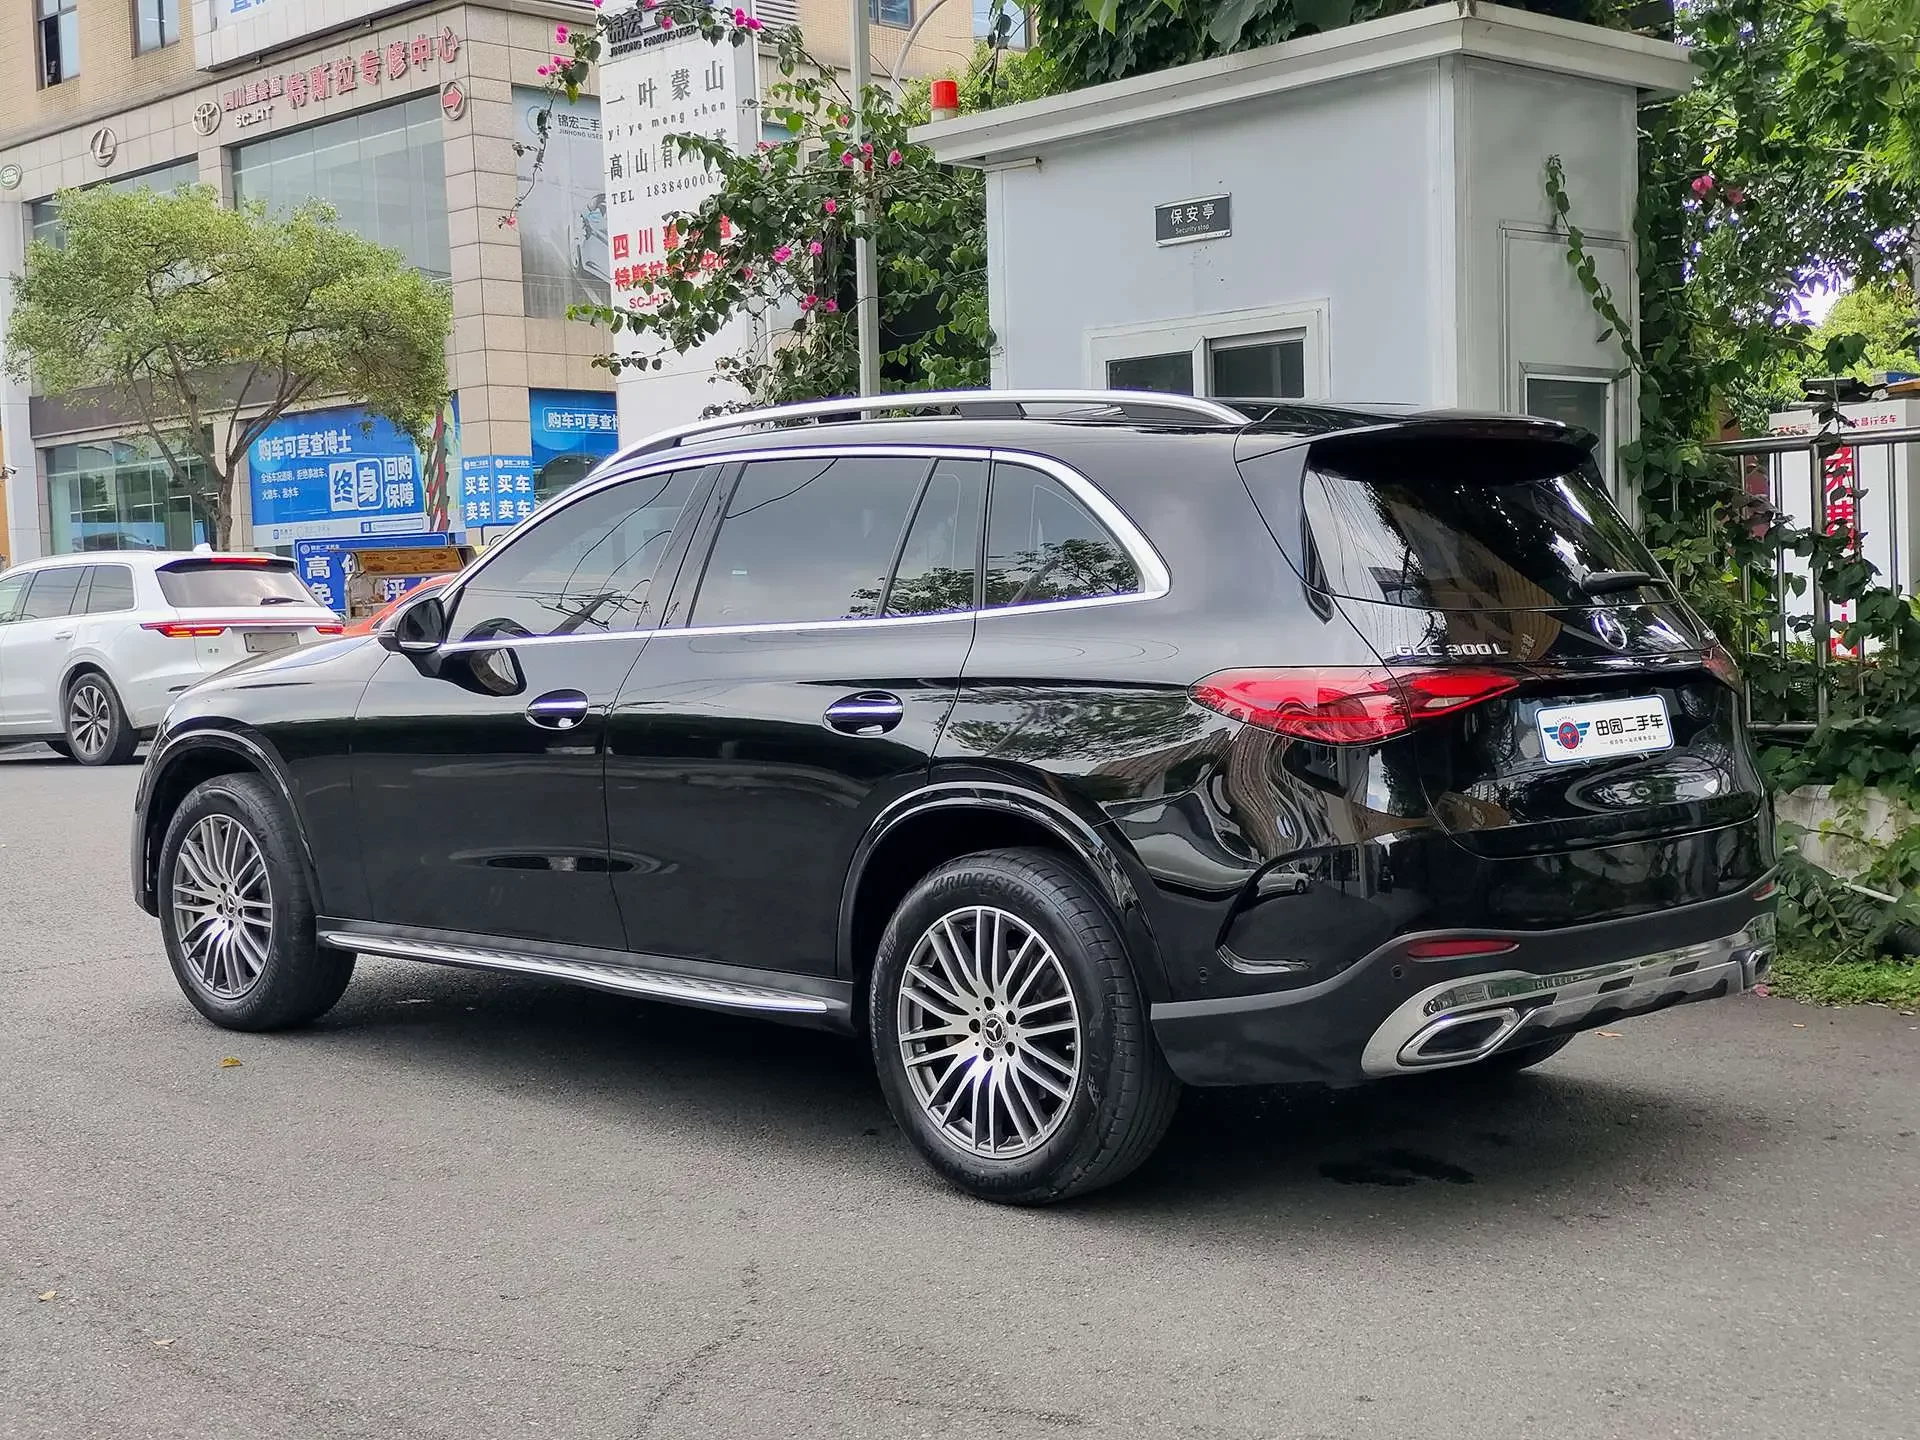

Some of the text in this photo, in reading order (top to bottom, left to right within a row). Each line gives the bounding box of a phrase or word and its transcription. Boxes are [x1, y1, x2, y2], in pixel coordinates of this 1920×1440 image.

[609, 40, 642, 58] JINHONG
[643, 31, 675, 48] FAMOUS
[285, 26, 460, 110] 特斯拉专修中心
[606, 60, 725, 109] 一叶蒙山
[694, 102, 726, 117] shan
[612, 190, 635, 205] TEL
[1170, 203, 1215, 226] 保安亭
[258, 428, 352, 461] 购车可享查博士
[384, 455, 413, 482] 回购
[333, 466, 380, 504] 终身
[385, 482, 415, 509] 保障
[464, 475, 490, 496] 买车
[497, 474, 531, 494] 买车
[466, 501, 491, 520] 卖车
[498, 499, 532, 519] 卖车
[1396, 644, 1443, 656] GLC
[1595, 713, 1664, 736] 田园二手车
